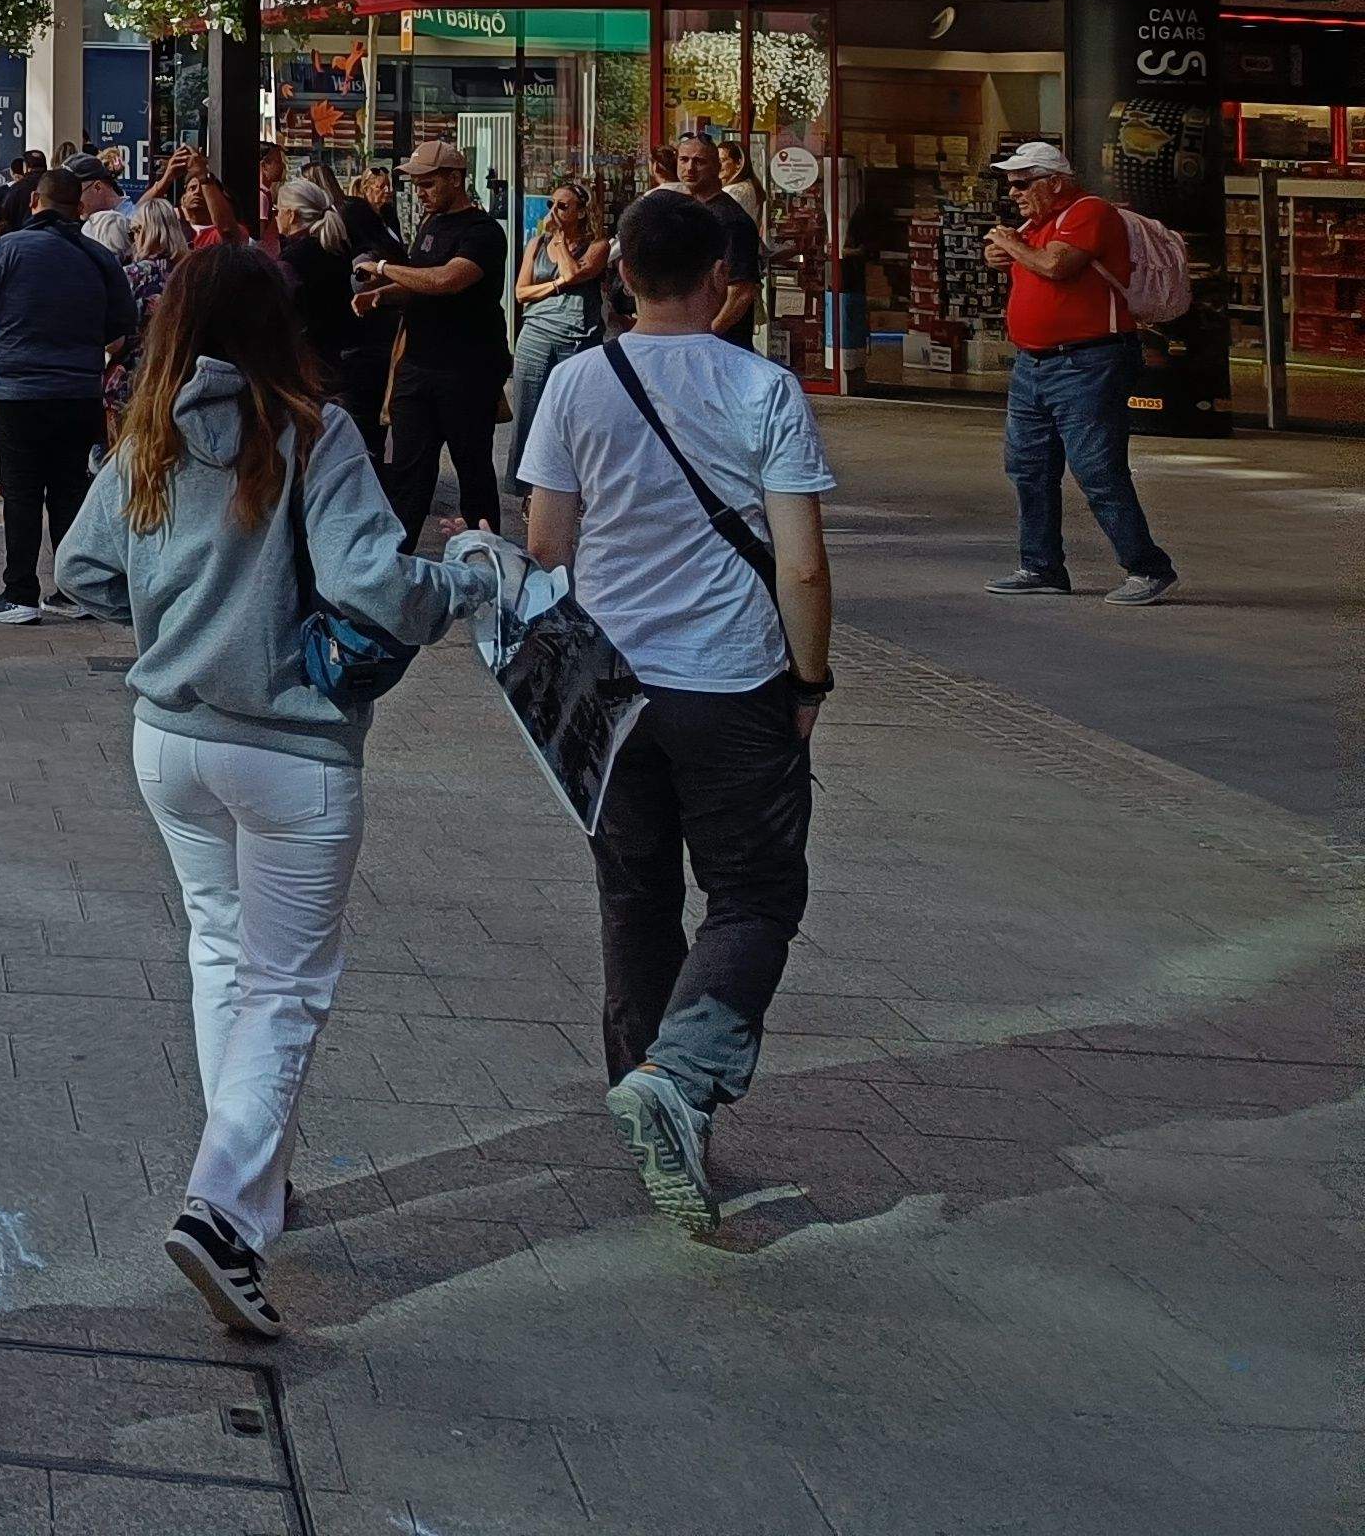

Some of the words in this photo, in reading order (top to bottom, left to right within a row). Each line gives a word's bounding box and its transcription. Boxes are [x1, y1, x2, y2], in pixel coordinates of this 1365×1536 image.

[1149, 8, 1198, 22] CAVA
[1138, 25, 1206, 40] CIGARS
[503, 79, 555, 96] Wston
